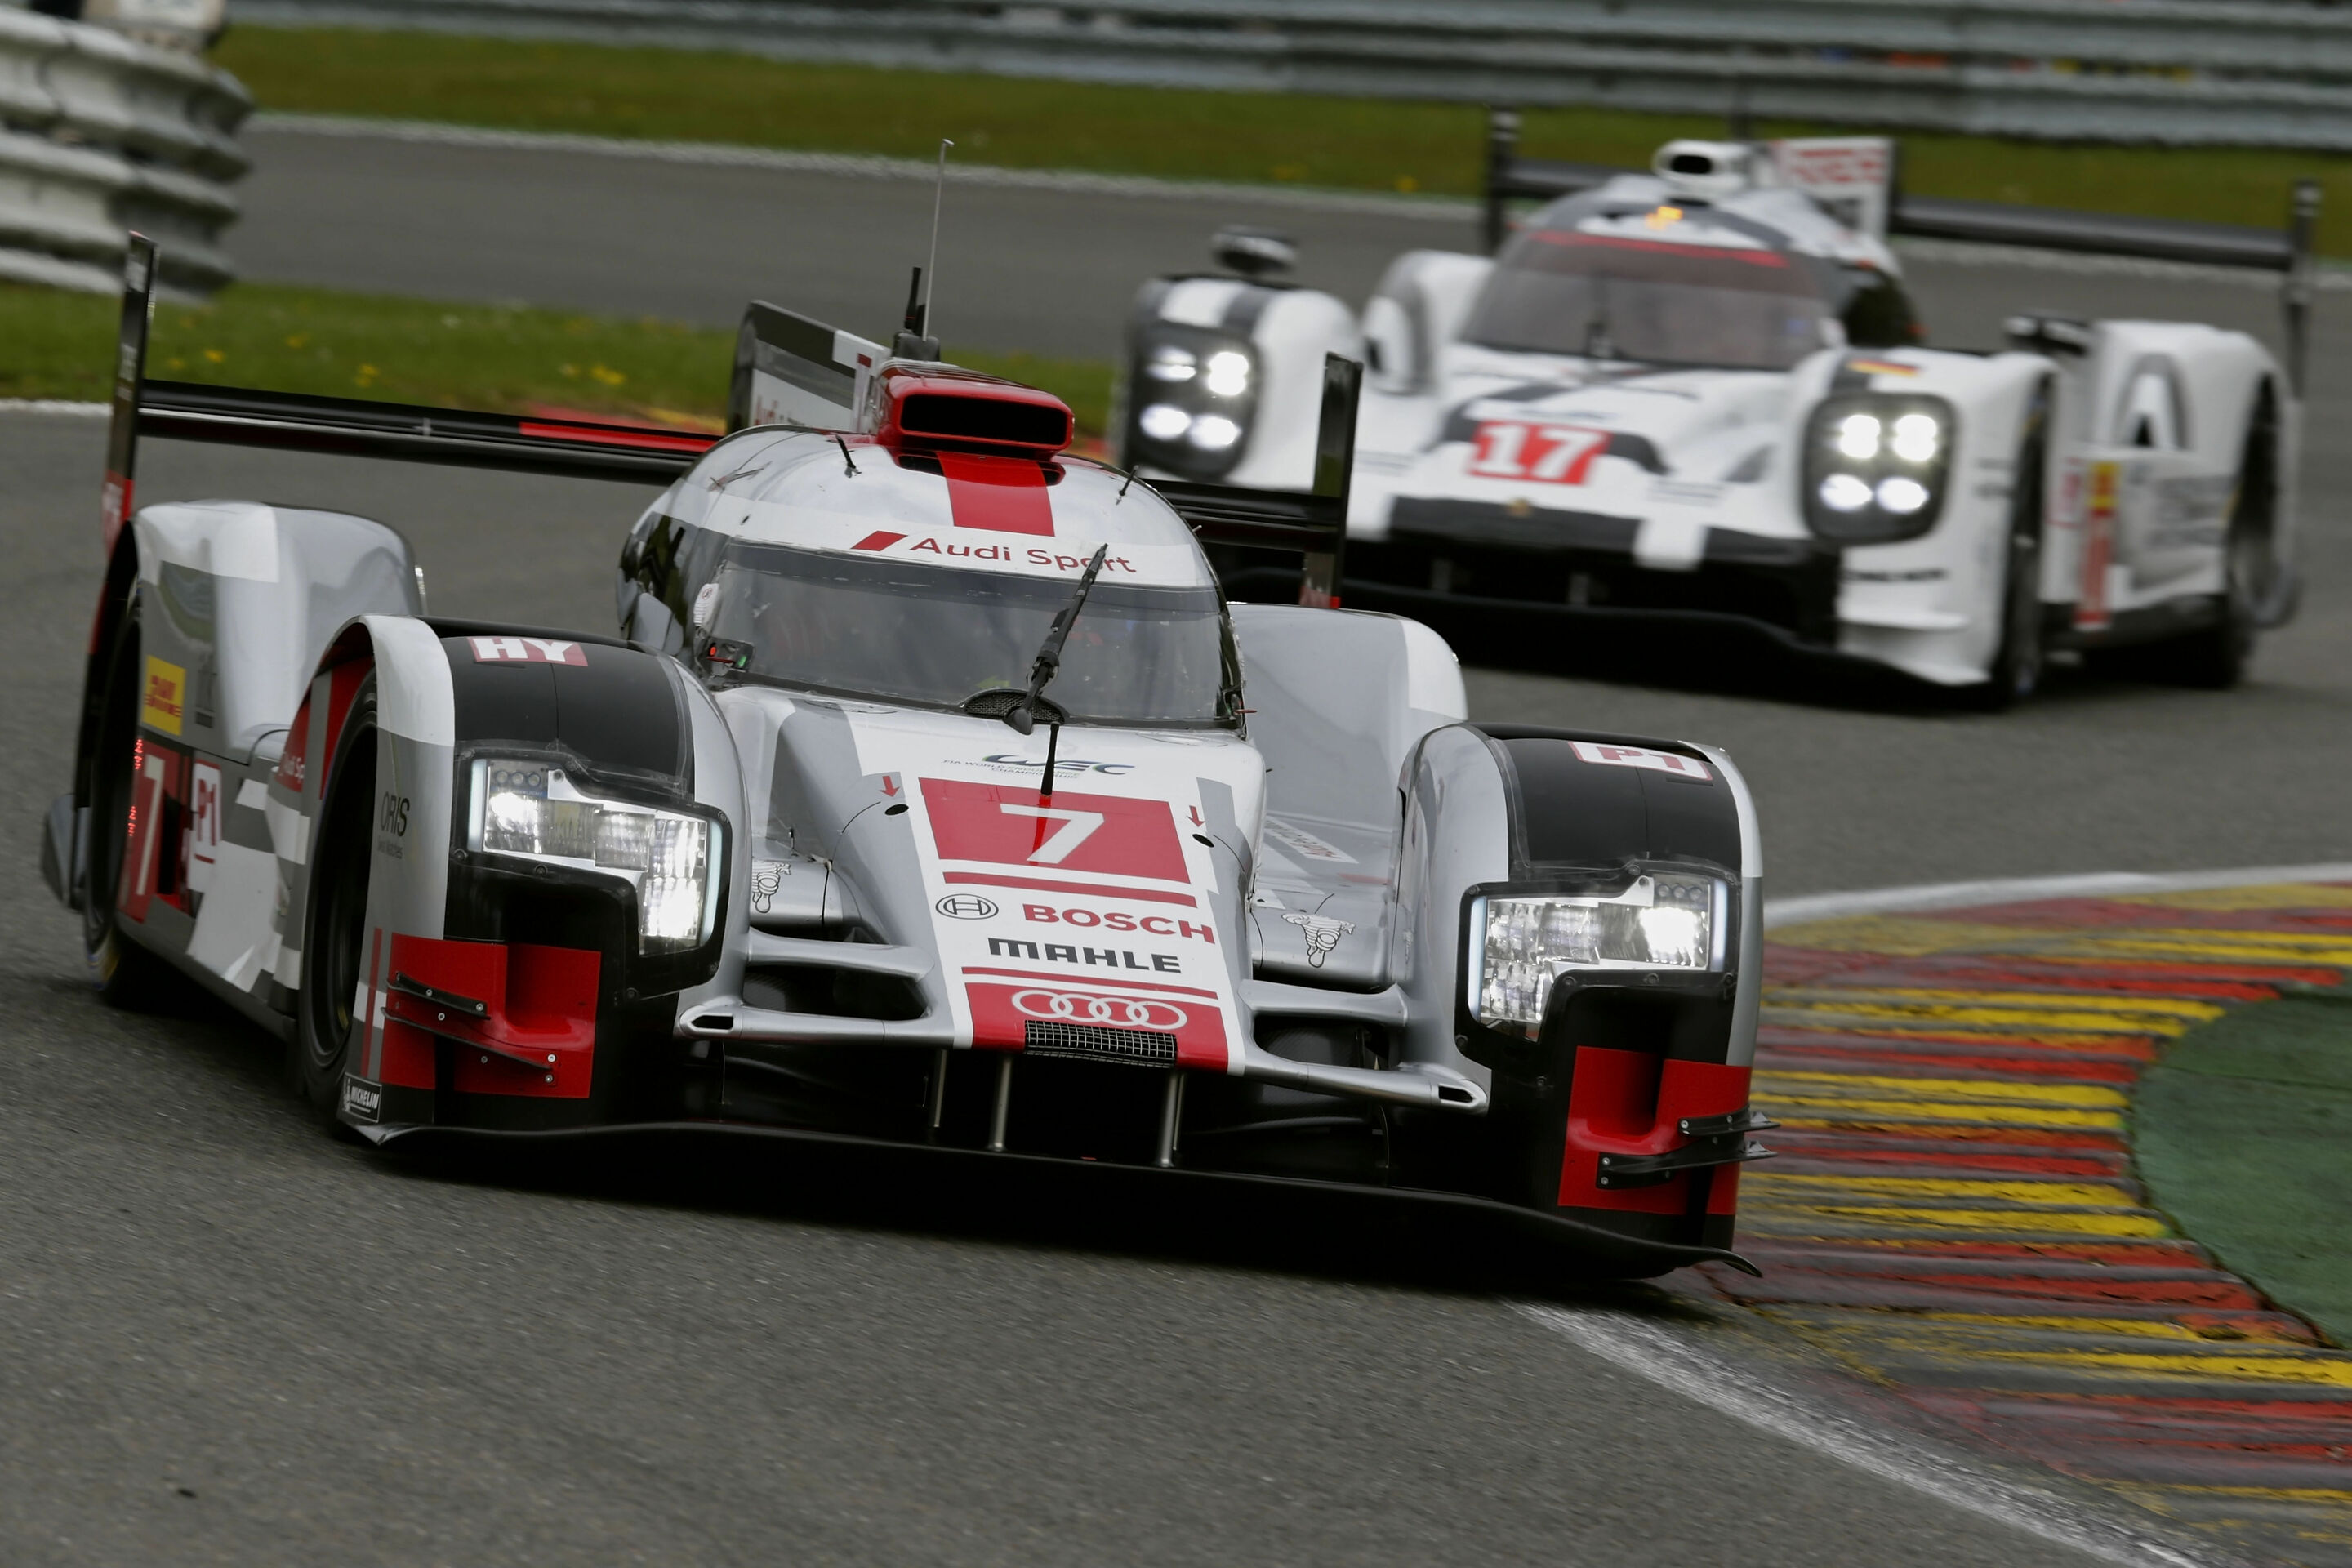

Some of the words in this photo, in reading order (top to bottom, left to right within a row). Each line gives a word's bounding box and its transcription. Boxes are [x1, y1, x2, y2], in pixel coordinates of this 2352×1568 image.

[1476, 425, 1610, 481] 17
[910, 537, 1011, 561] Audi
[1026, 549, 1138, 573] Sport
[472, 638, 573, 662] HY
[1597, 746, 1686, 770] P1
[136, 753, 165, 895] 7
[381, 791, 410, 837] ORIS
[1000, 804, 1104, 864] 7
[1022, 903, 1215, 944] BOSCH
[988, 938, 1181, 973] MAHLE
